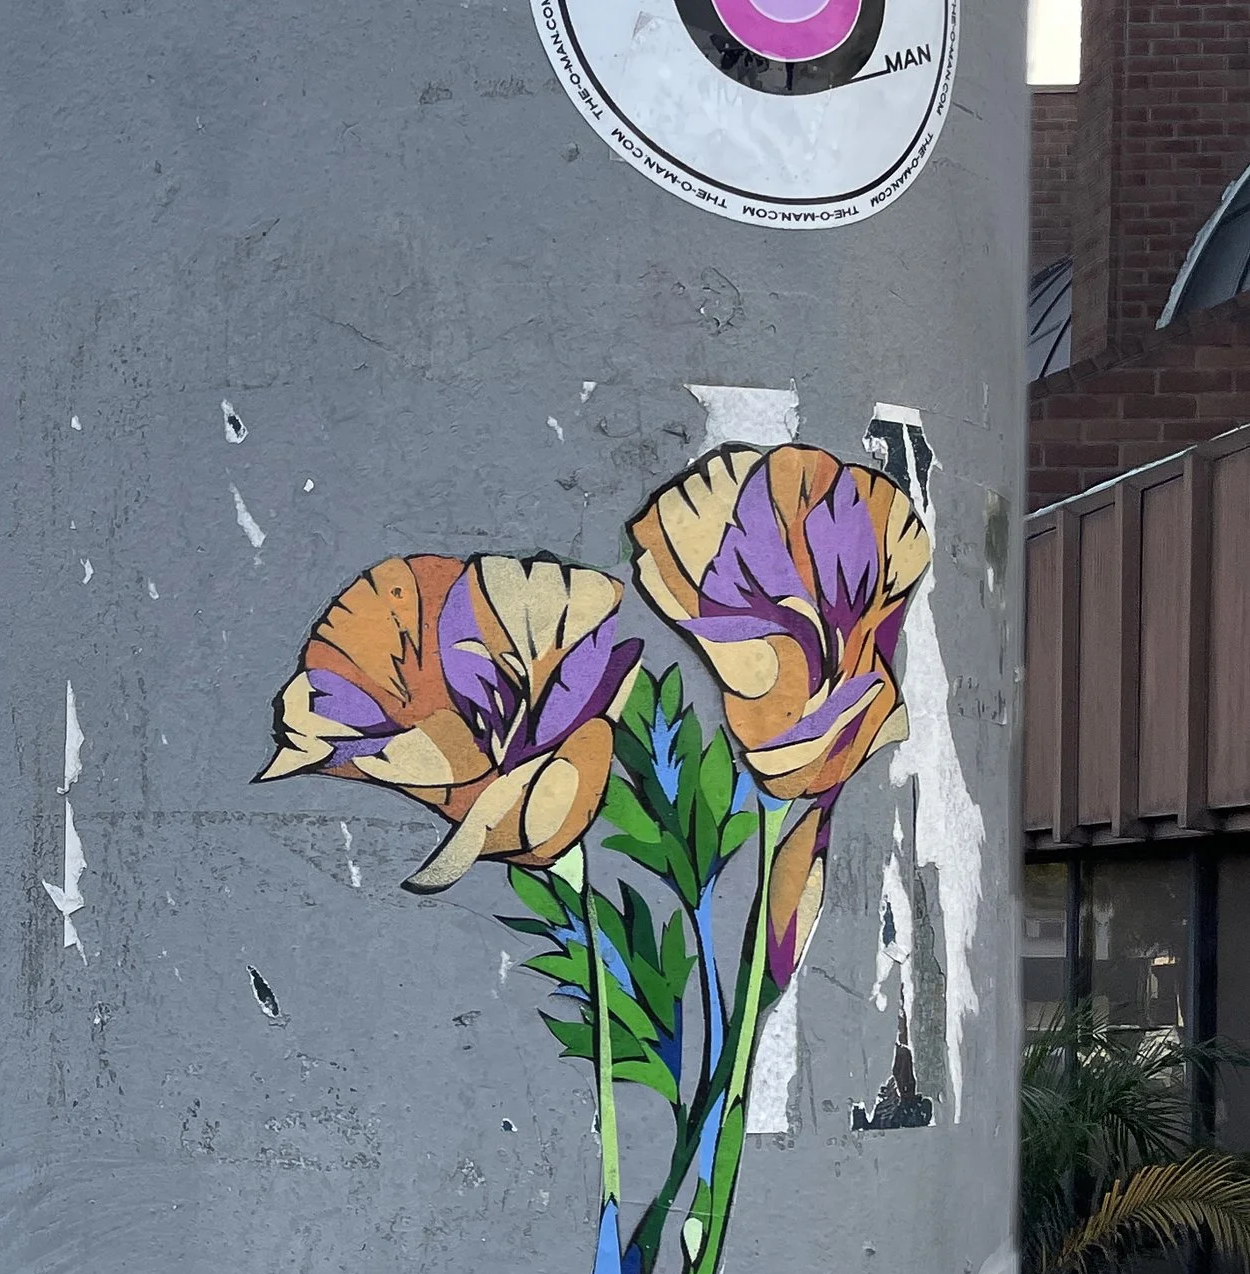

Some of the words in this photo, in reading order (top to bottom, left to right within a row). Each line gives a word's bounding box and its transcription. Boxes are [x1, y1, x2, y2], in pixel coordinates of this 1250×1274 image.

[884, 44, 932, 73] MAN
[610, 127, 729, 209] THE-O-MAN.COM
[870, 132, 934, 207] THE-O-MAN.COM
[742, 205, 860, 222] THE-O-MAN.COM
